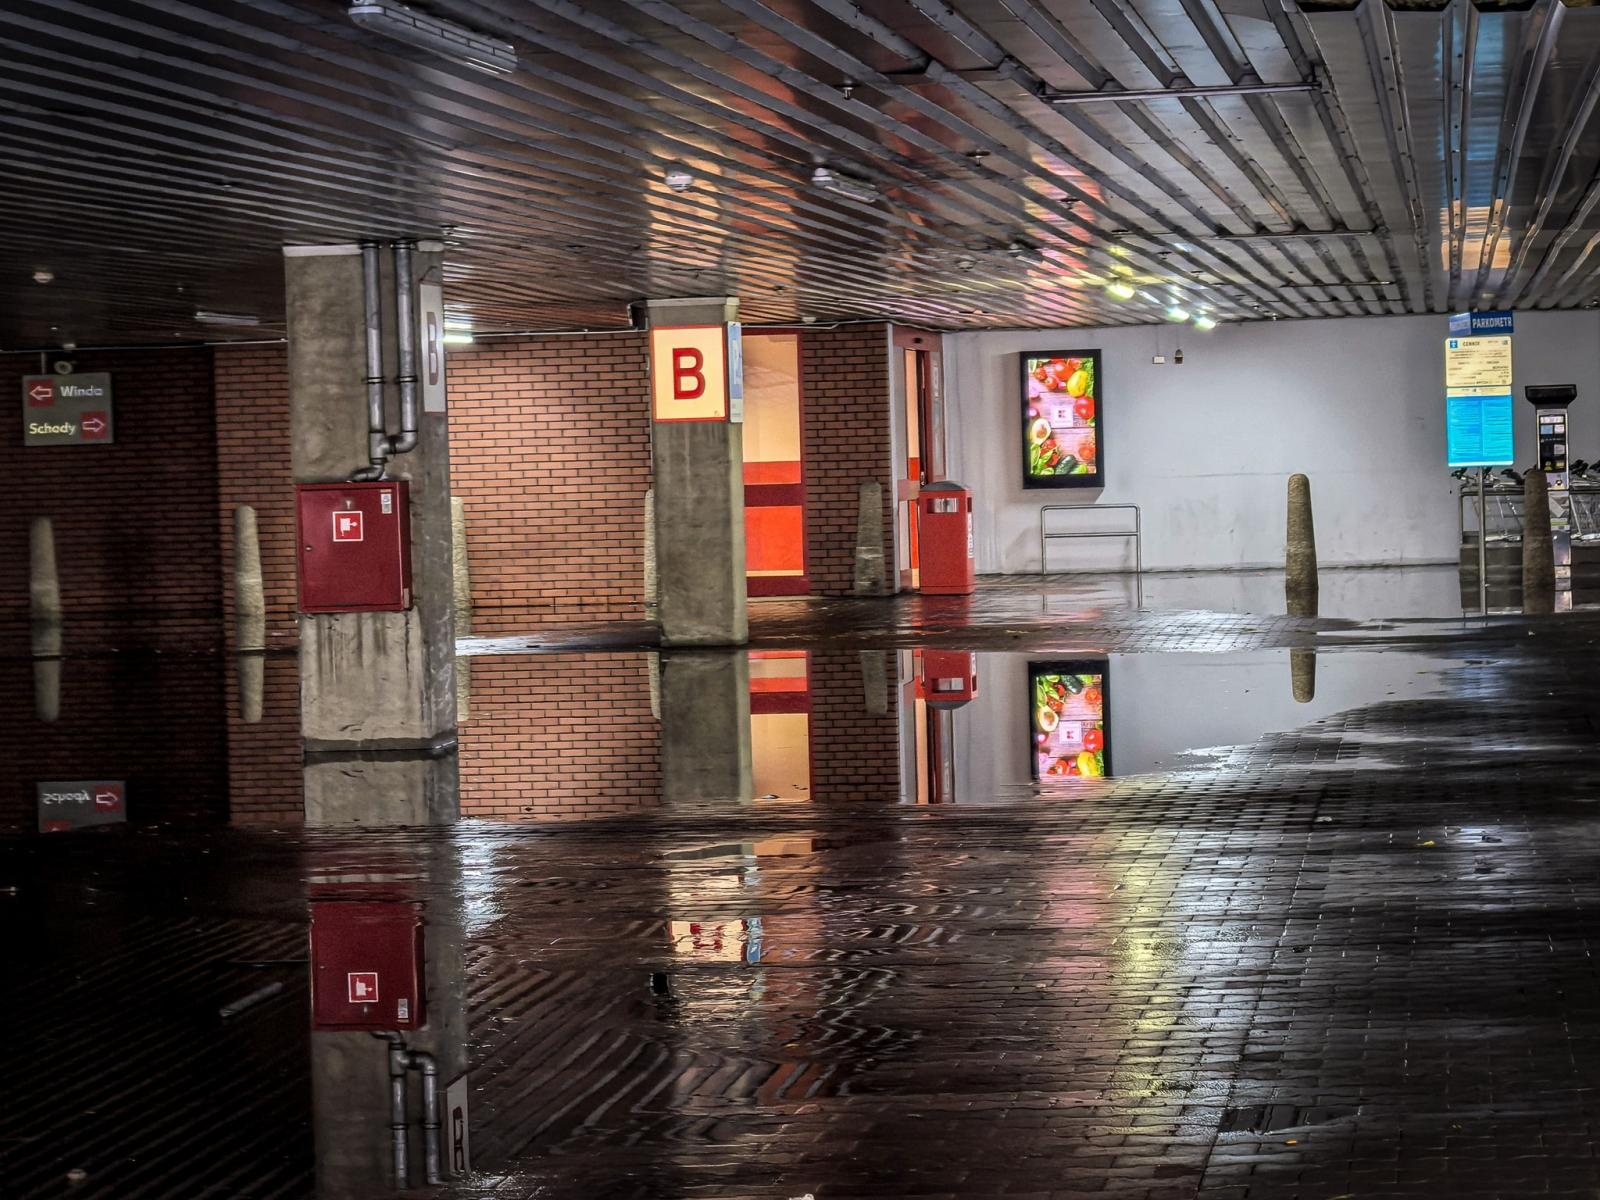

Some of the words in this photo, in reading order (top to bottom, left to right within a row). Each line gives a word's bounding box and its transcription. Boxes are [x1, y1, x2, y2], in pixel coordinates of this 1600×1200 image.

[1472, 316, 1513, 328] PARKOMETR
[672, 347, 706, 400] B
[60, 385, 104, 397] Winda
[29, 421, 76, 435] Schody
